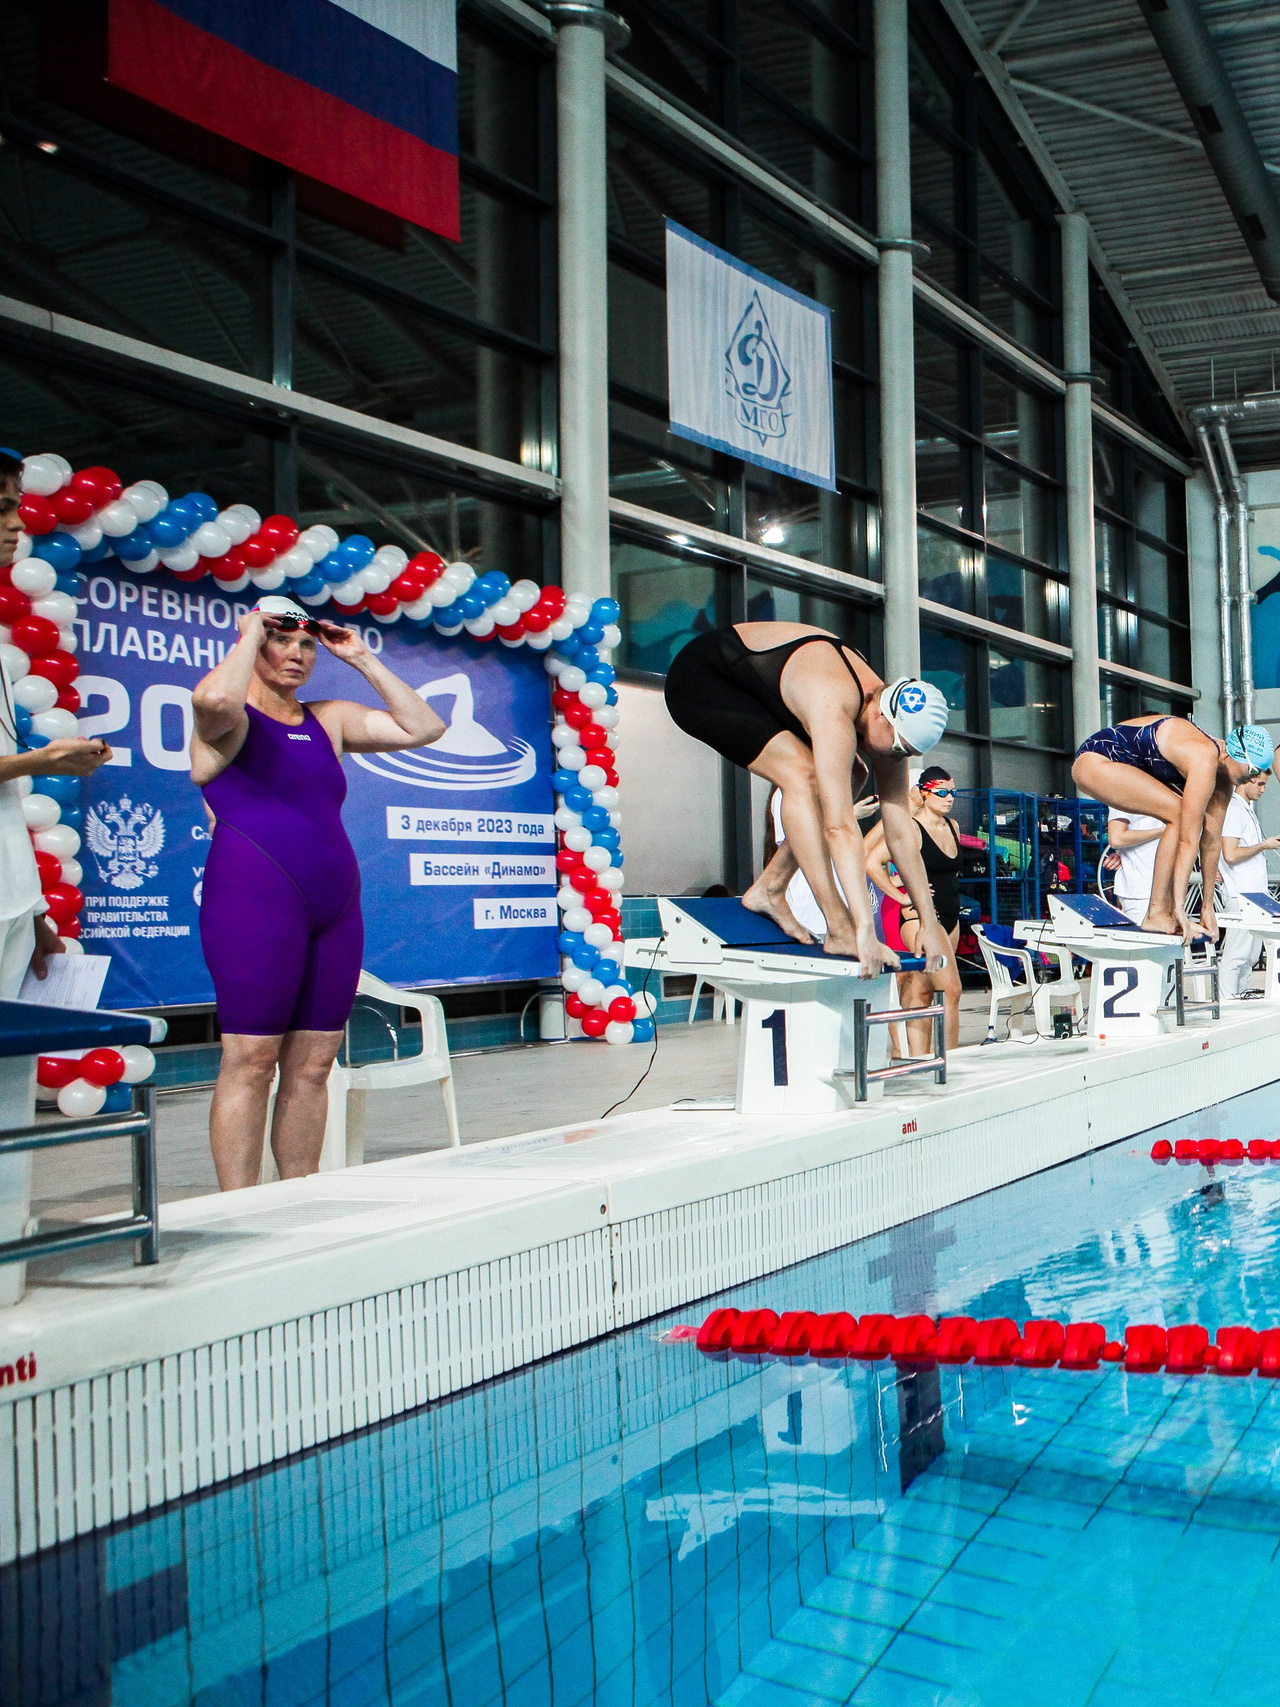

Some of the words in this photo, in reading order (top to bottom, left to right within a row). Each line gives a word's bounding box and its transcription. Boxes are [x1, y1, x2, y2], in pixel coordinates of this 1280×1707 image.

[740, 403, 779, 431] МГО
[401, 815, 410, 830] 3
[416, 817, 472, 835] декабря
[477, 818, 513, 833] 2023
[517, 823, 544, 836] года
[423, 860, 479, 876] Бассейн
[484, 861, 546, 879] «Динамо»
[85, 896, 106, 907] ПРИ
[108, 896, 169, 909] ПОДДЕРЖКЕ
[87, 911, 169, 923] ПРАВИТЕЛЬСТВА
[485, 909, 494, 920] г.
[500, 905, 547, 919] Москва
[78, 925, 130, 939] ССИЙСКОЙ
[132, 925, 190, 939] ФЕДЕРАЦИИ
[1103, 966, 1140, 1018] 2
[762, 1009, 789, 1086] 1
[902, 1117, 918, 1134] anti
[0, 1350, 37, 1388] nti
